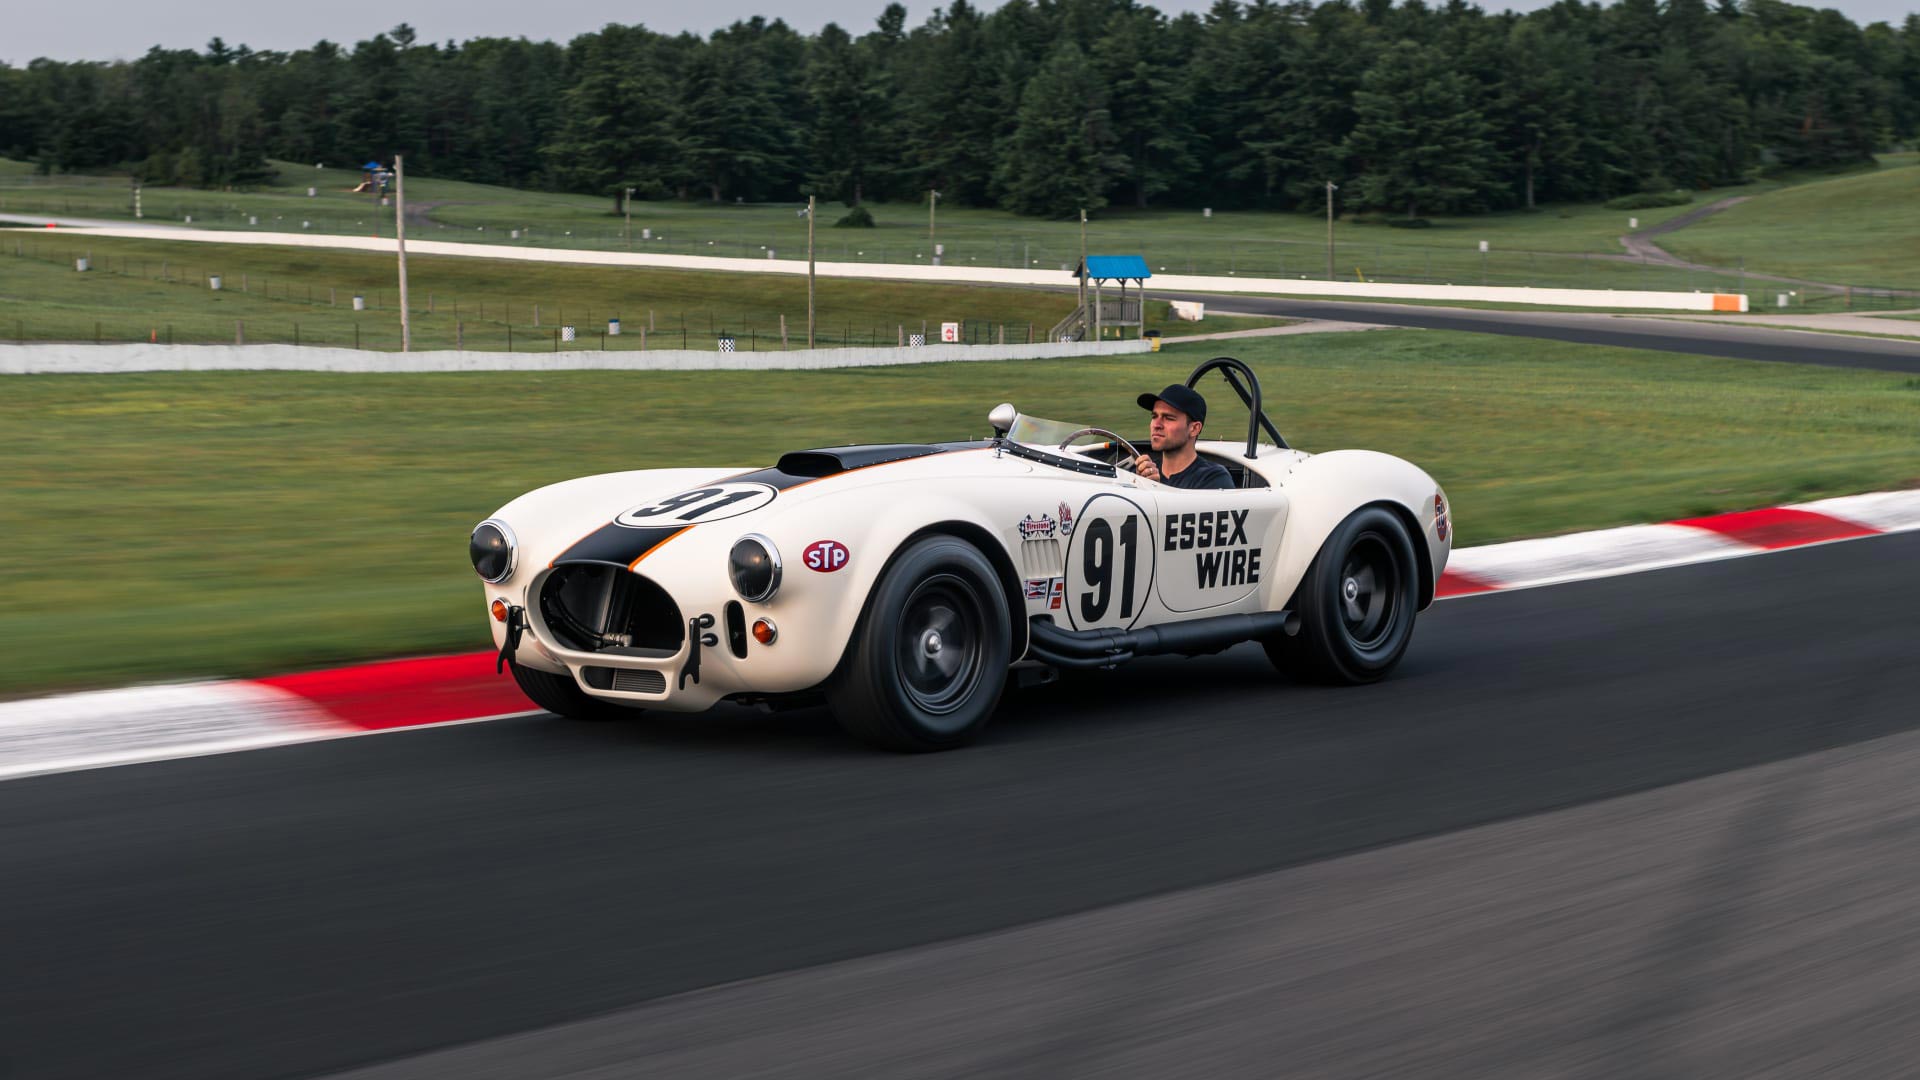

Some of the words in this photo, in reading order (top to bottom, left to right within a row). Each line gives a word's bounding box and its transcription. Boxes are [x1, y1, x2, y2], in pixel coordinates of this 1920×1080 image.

[631, 488, 763, 521] 91
[1164, 509, 1249, 551] ESSEX
[808, 542, 846, 568] STP
[1081, 514, 1137, 623] 91
[1196, 548, 1261, 589] WIRE
